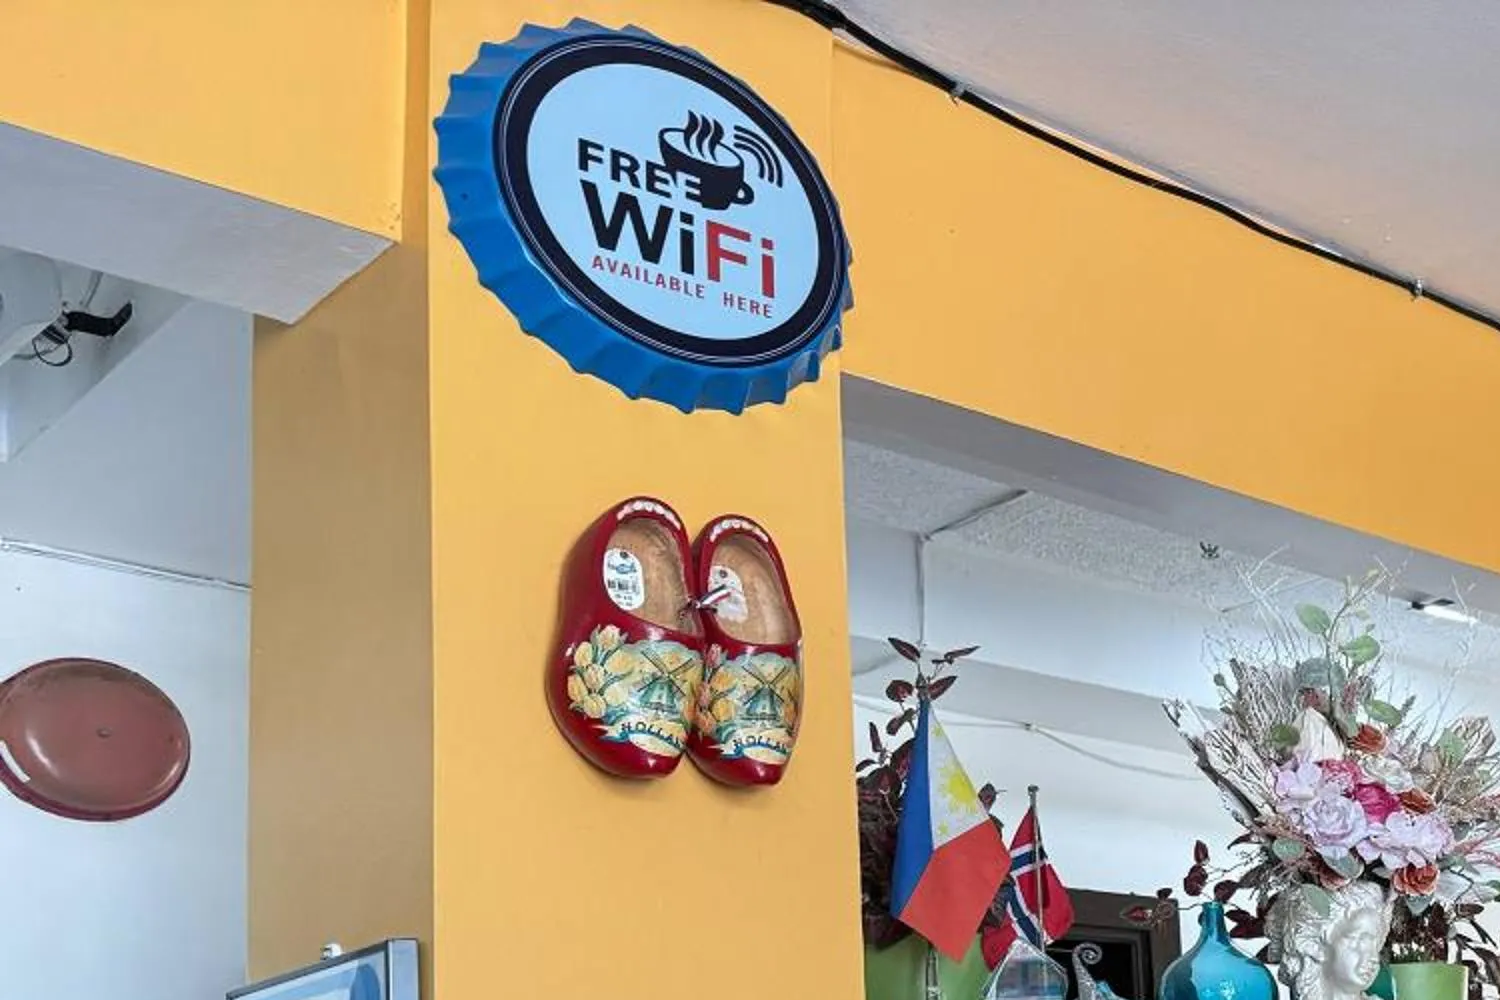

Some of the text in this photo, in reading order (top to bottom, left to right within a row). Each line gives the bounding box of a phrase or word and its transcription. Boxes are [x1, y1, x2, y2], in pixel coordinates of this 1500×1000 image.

[578, 137, 701, 201] FREE
[579, 179, 776, 299] WiFi
[591, 254, 774, 319] AVAILABLE HERE
[621, 721, 682, 749] HOLLAN
